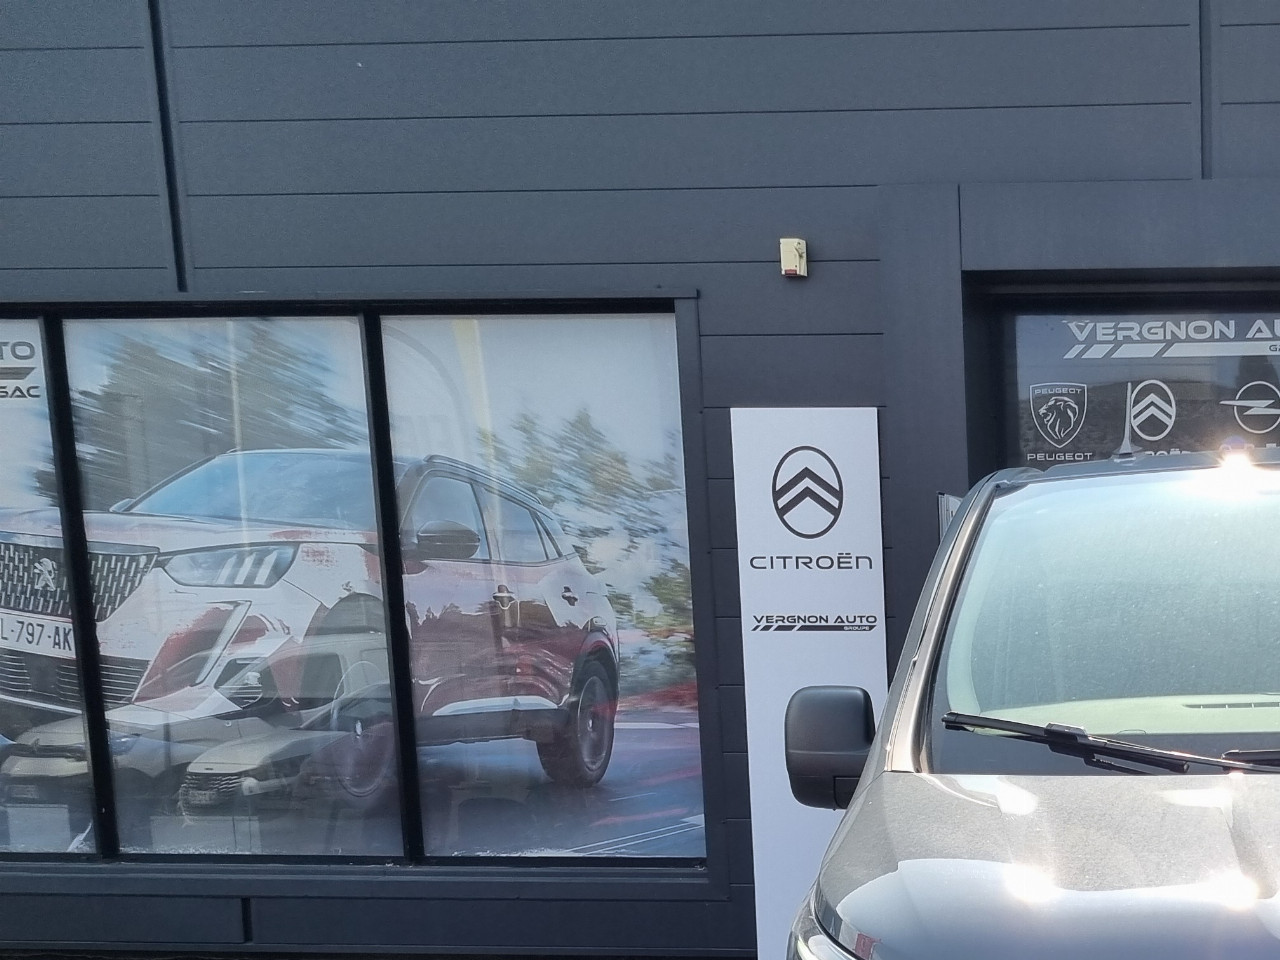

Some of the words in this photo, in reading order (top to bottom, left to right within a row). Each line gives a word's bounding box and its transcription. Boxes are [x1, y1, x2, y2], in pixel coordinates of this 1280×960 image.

[1067, 319, 1235, 342] VERGNON
[1034, 387, 1082, 395] PEUGEOT
[1027, 452, 1093, 461] PEUGEOT
[753, 615, 829, 624] VERGNON
[833, 615, 878, 624] AUTO
